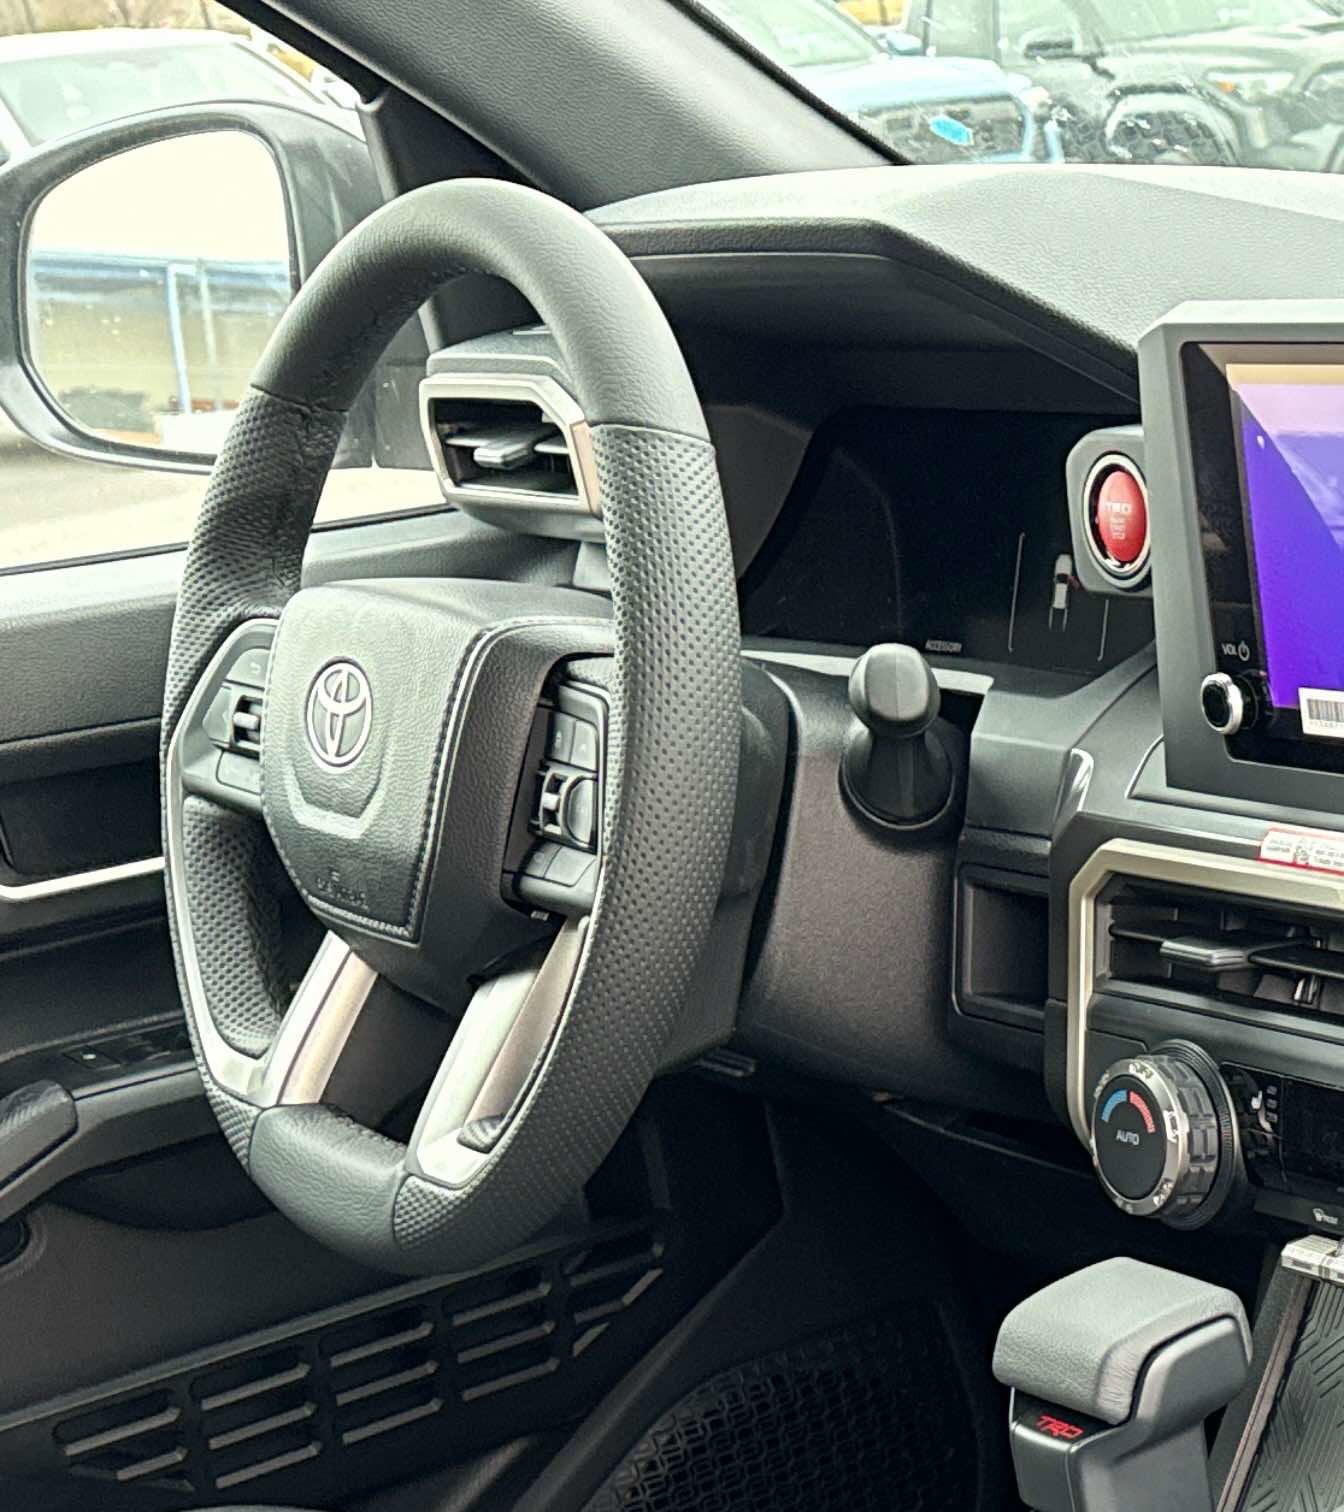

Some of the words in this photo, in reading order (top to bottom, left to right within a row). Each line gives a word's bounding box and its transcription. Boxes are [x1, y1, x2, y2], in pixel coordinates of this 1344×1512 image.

[1221, 642, 1238, 657] VOL
[1115, 1129, 1140, 1146] AUTO
[1036, 1415, 1084, 1439] TRD
